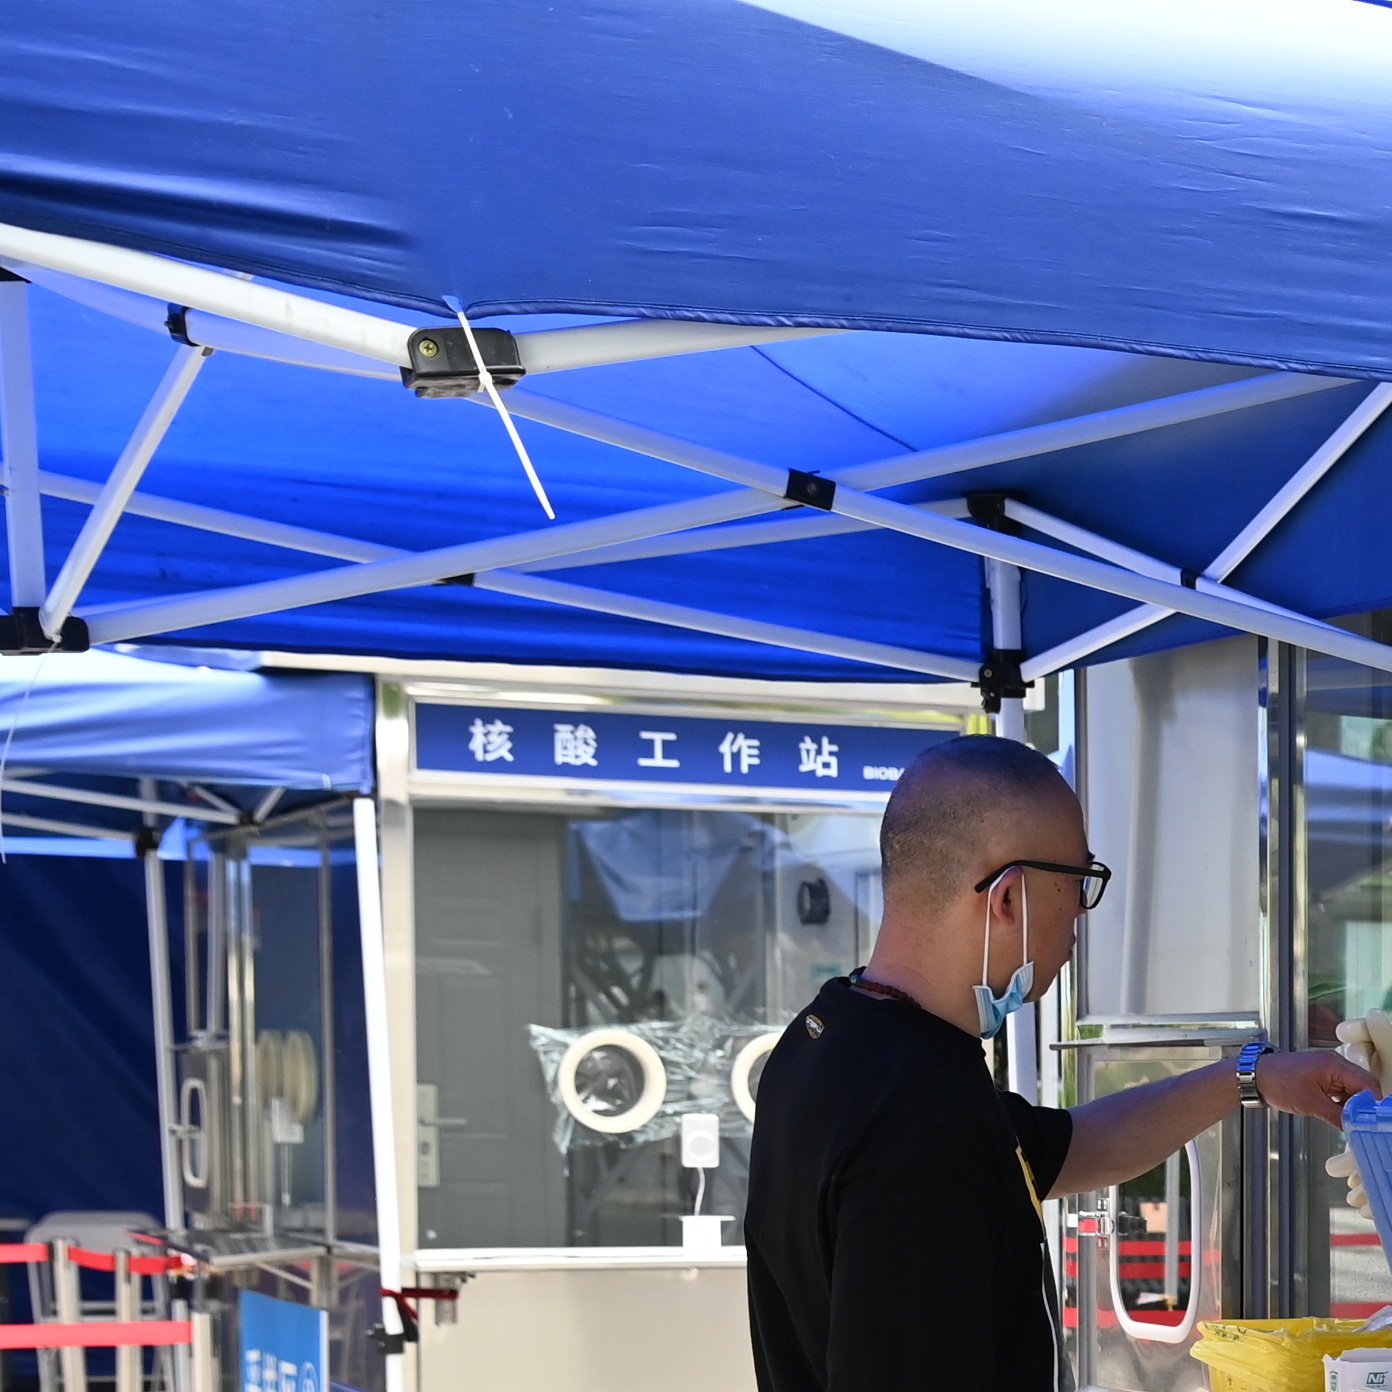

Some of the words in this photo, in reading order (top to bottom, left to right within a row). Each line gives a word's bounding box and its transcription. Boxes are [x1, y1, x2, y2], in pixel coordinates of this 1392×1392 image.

[469, 717, 839, 780] 核酸工作站
